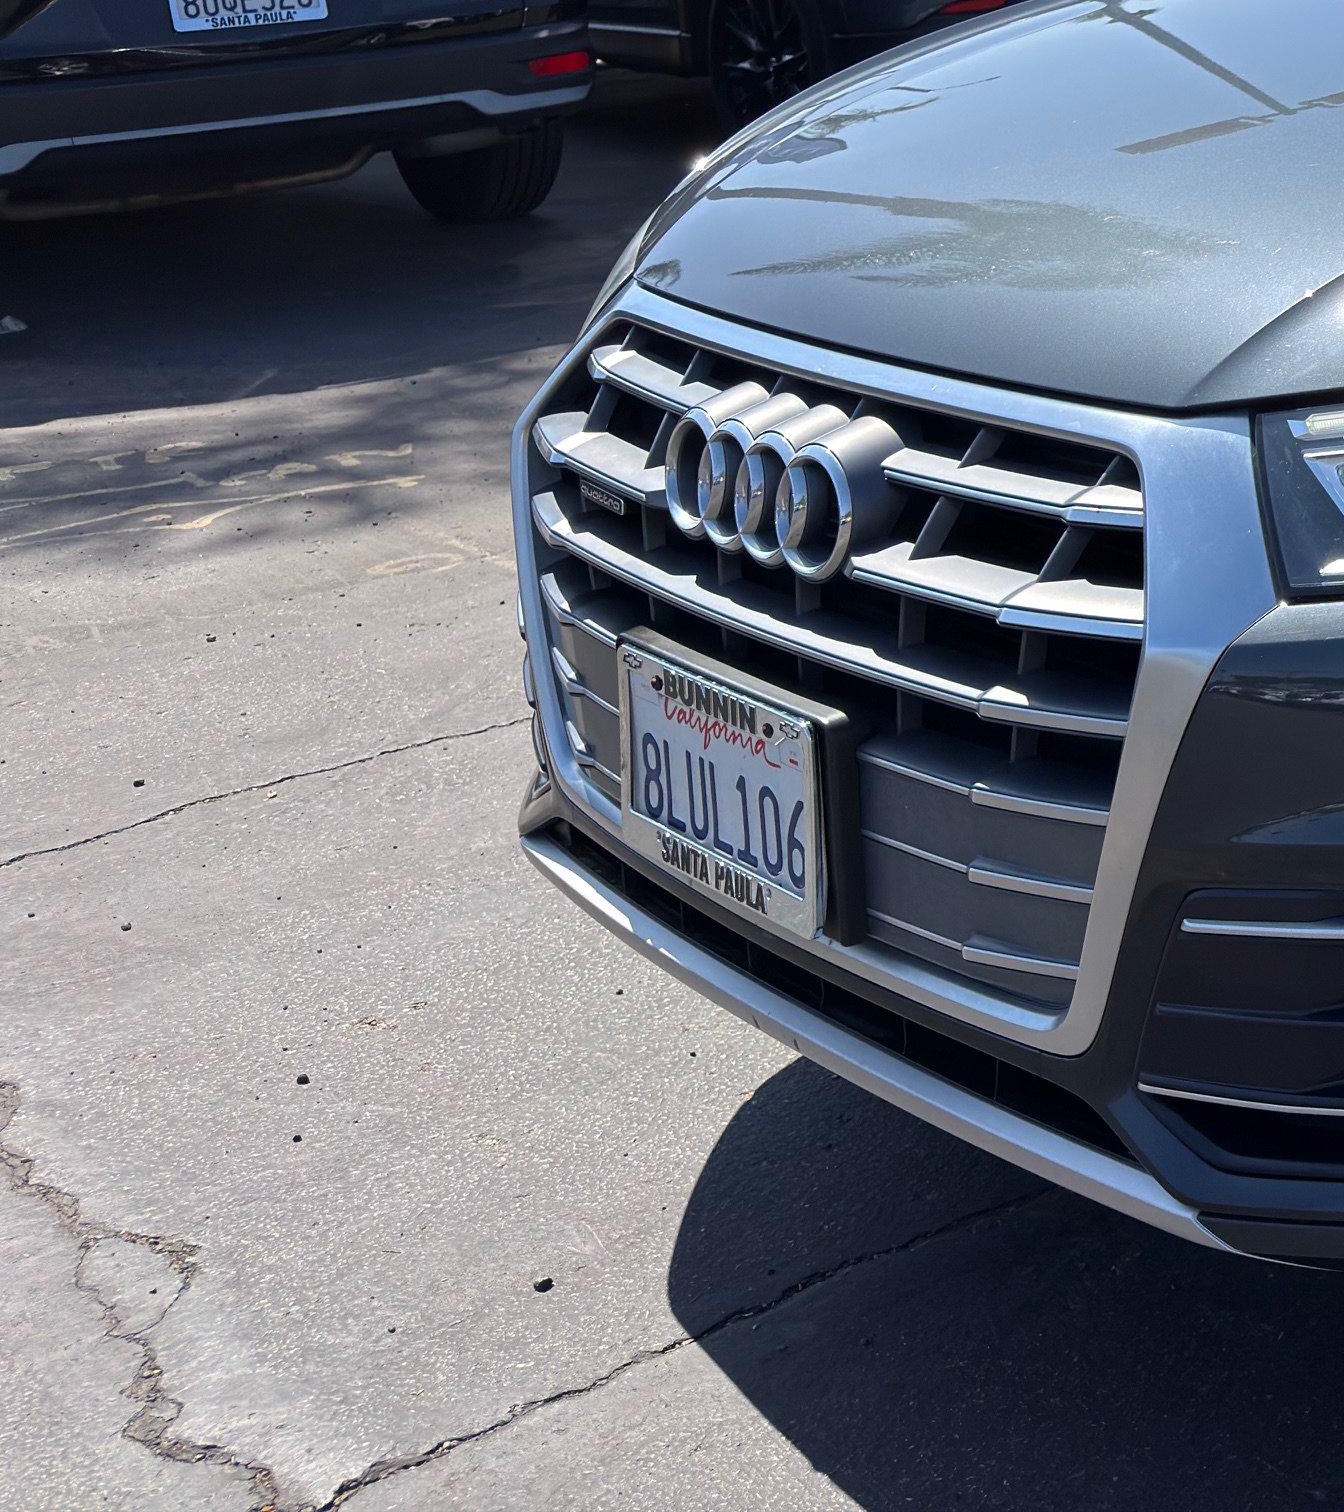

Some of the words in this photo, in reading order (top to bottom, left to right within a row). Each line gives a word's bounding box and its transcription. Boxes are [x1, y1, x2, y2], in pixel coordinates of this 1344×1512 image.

[662, 669, 758, 735] BUNNIN
[662, 696, 782, 769] California
[641, 731, 807, 890] 8LUL106
